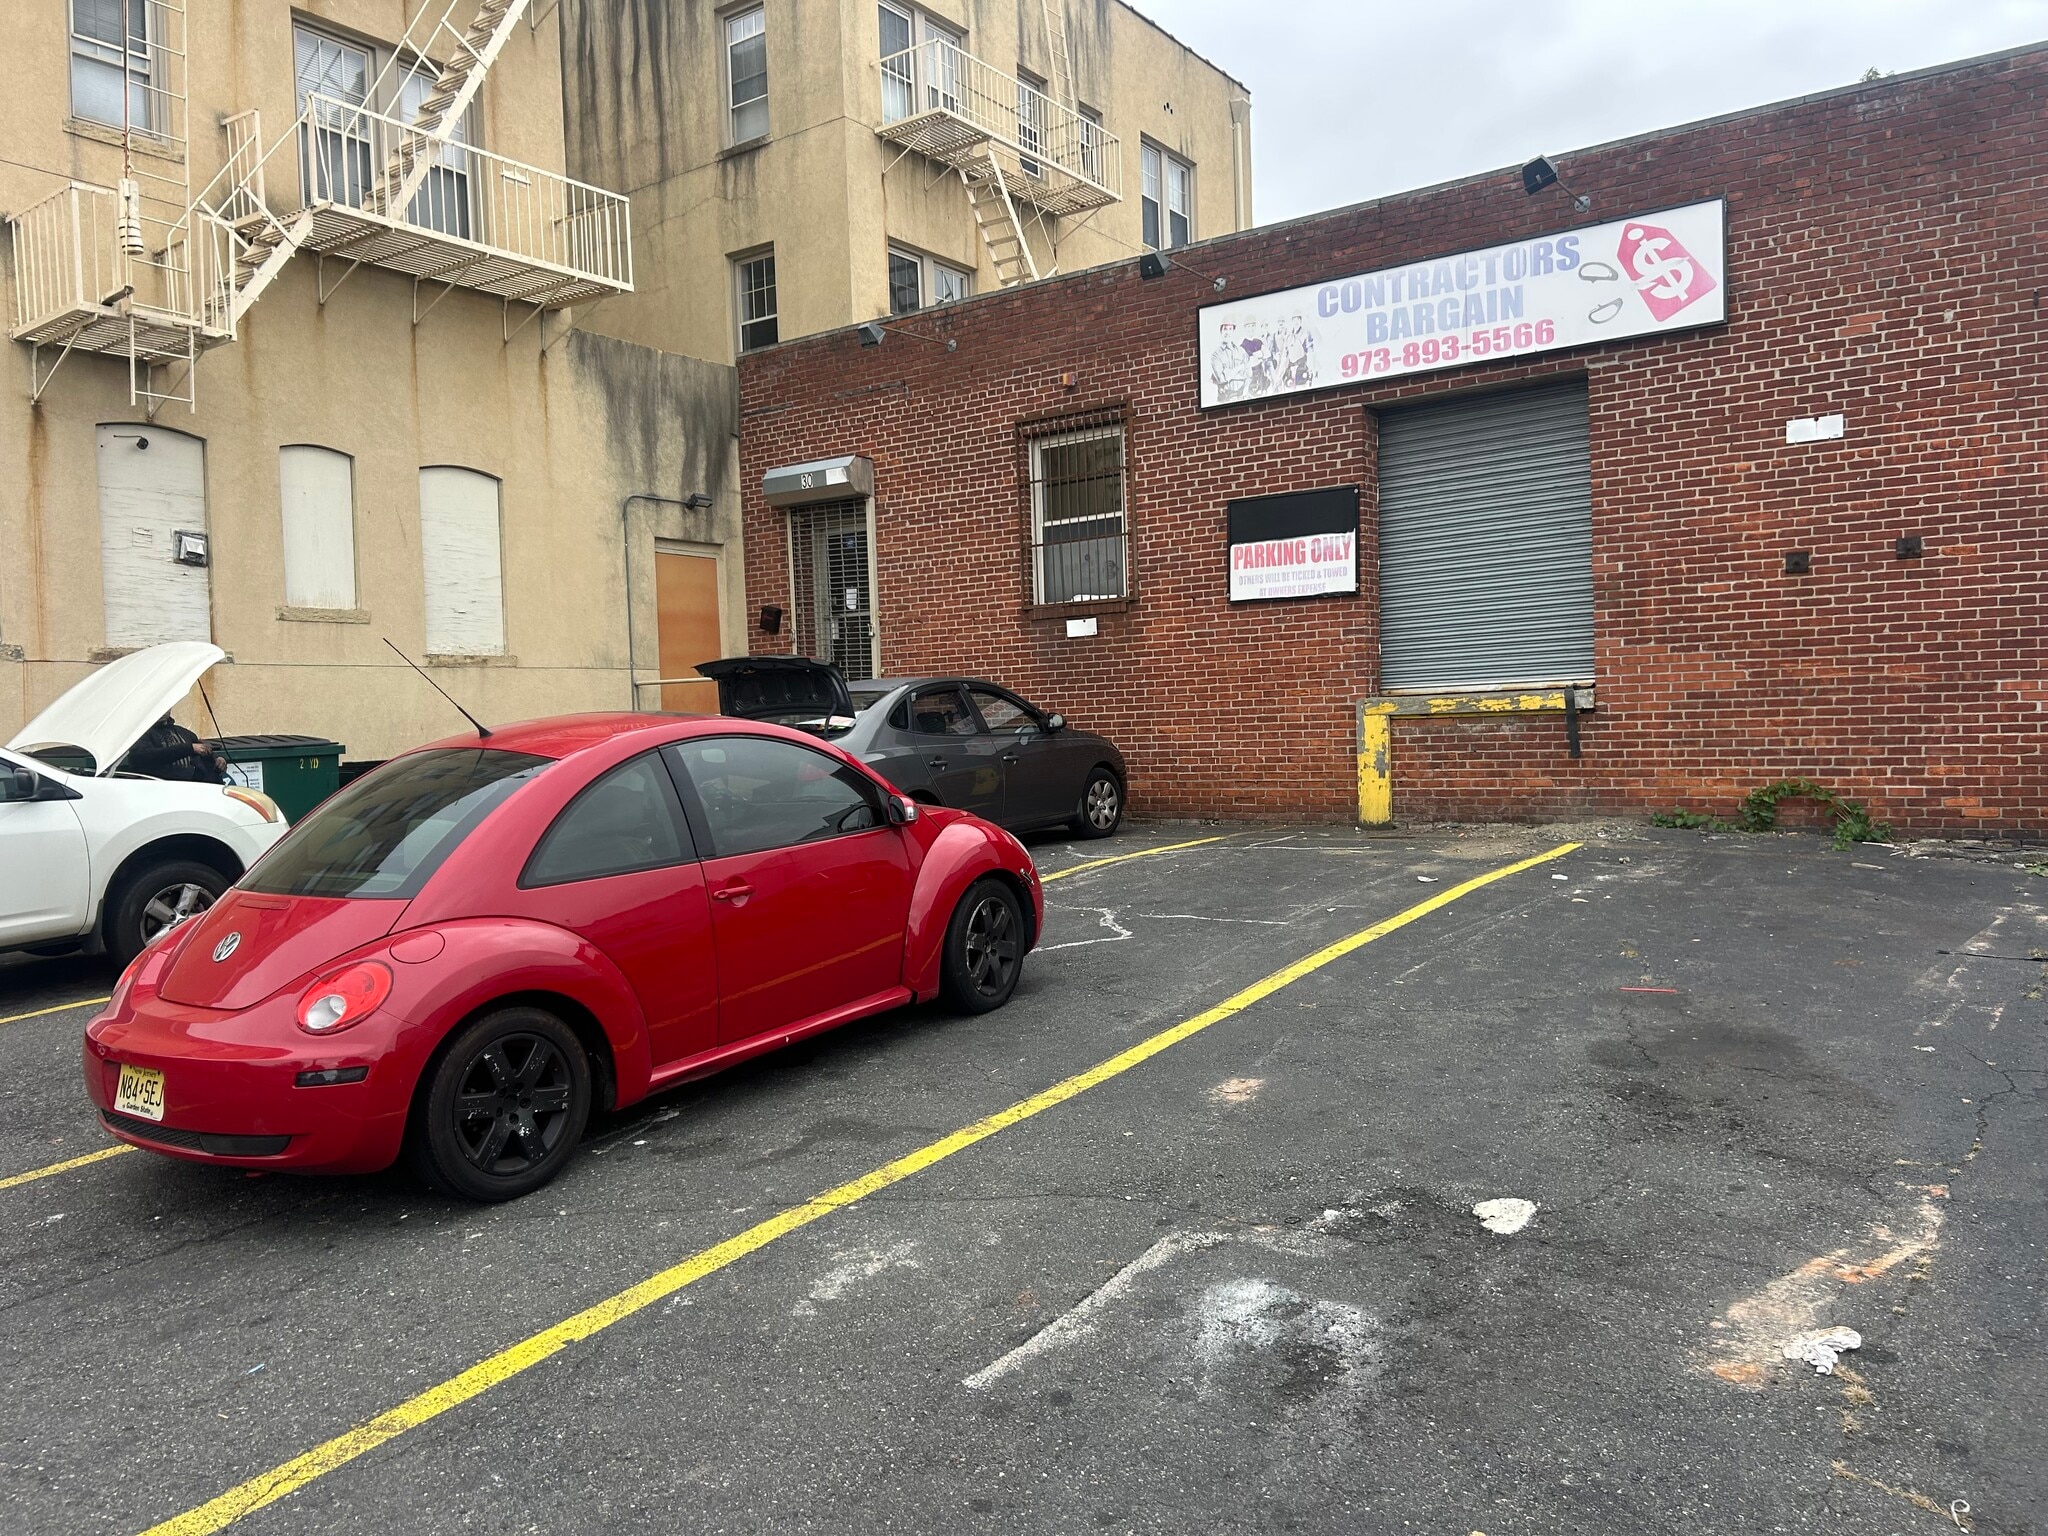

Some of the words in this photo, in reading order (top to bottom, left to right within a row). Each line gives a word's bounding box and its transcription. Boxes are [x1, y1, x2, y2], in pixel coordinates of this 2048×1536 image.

[1317, 235, 1581, 318] CONTRACTORS
[1366, 285, 1524, 345] BARGAIN
[1341, 318, 1555, 379] 973-893-5566
[801, 473, 813, 488] 30
[1234, 539, 1306, 570] PARKING
[1311, 535, 1352, 563] ONLY
[1238, 575, 1264, 586] OTHERS
[1265, 573, 1280, 583] WILL
[1282, 572, 1290, 582] BE
[1323, 566, 1348, 578] TOWED
[1268, 585, 1297, 597] OWNERS
[1298, 583, 1326, 595] EXPENSE
